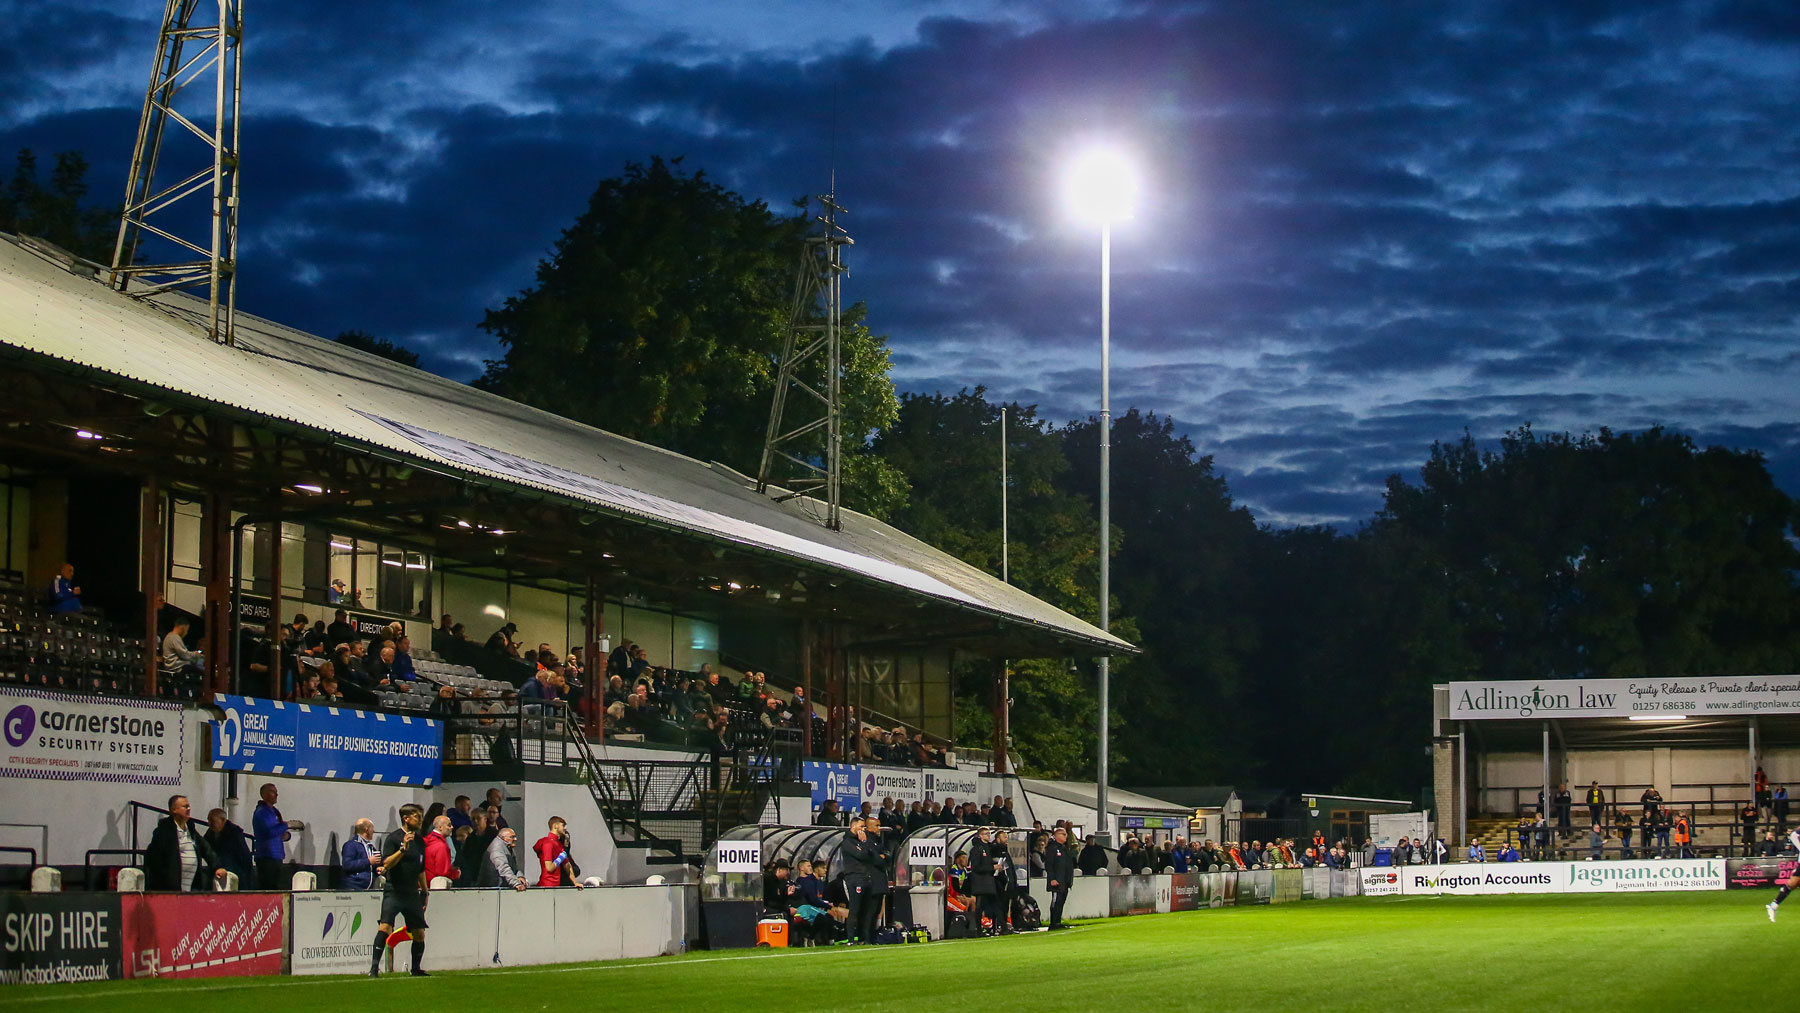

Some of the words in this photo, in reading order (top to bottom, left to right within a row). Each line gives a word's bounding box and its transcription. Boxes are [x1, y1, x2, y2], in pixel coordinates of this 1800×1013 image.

[254, 606, 271, 618] AREA
[1628, 684, 1658, 699] Equity
[1661, 683, 1697, 695] Release
[1700, 685, 1706, 693] &
[1708, 682, 1742, 693] Private
[1744, 681, 1769, 693] client
[1457, 685, 1569, 717] Adlington
[1578, 685, 1617, 708] law
[1632, 702, 1660, 711] 01257
[1662, 701, 1696, 711] 686386
[40, 710, 165, 737] cornerstone
[243, 713, 269, 730] GREAT
[39, 736, 103, 752] SECURITY
[109, 741, 165, 756] SYSTEMS
[243, 732, 267, 746] ANNUAL
[268, 733, 295, 748] SAVINGS
[308, 733, 321, 748] WE
[322, 735, 342, 751] HELP
[344, 737, 388, 755] BUSINESSES
[389, 741, 417, 758] REDUCE
[418, 744, 439, 760] COSTS
[25, 757, 48, 766] SECURITY
[49, 759, 79, 767] SPECIALISTS
[876, 775, 916, 789] cornerstone
[936, 778, 959, 793] Buckshaw
[959, 779, 976, 796] Hospital
[720, 850, 758, 863] HOME
[911, 846, 944, 858] AWAY
[1364, 876, 1386, 885] signs
[1484, 873, 1551, 885] Accounts
[1570, 861, 1720, 886] Jagman.co.uk
[1615, 881, 1645, 890] Jagman
[1647, 880, 1657, 888] ltd
[1664, 880, 1688, 888] 01942
[5, 912, 54, 952] SKIP
[60, 911, 109, 950] HIRE
[220, 909, 247, 953] CHORLEY
[236, 908, 263, 951] LEYLAND
[253, 905, 280, 949] PRESTON
[171, 932, 190, 961] BURY
[189, 920, 214, 960] BOLTON
[204, 922, 227, 957] WIGAN
[301, 944, 340, 960] CROWBERRY
[342, 944, 373, 958] CONSULTI
[131, 948, 161, 978] LSH
